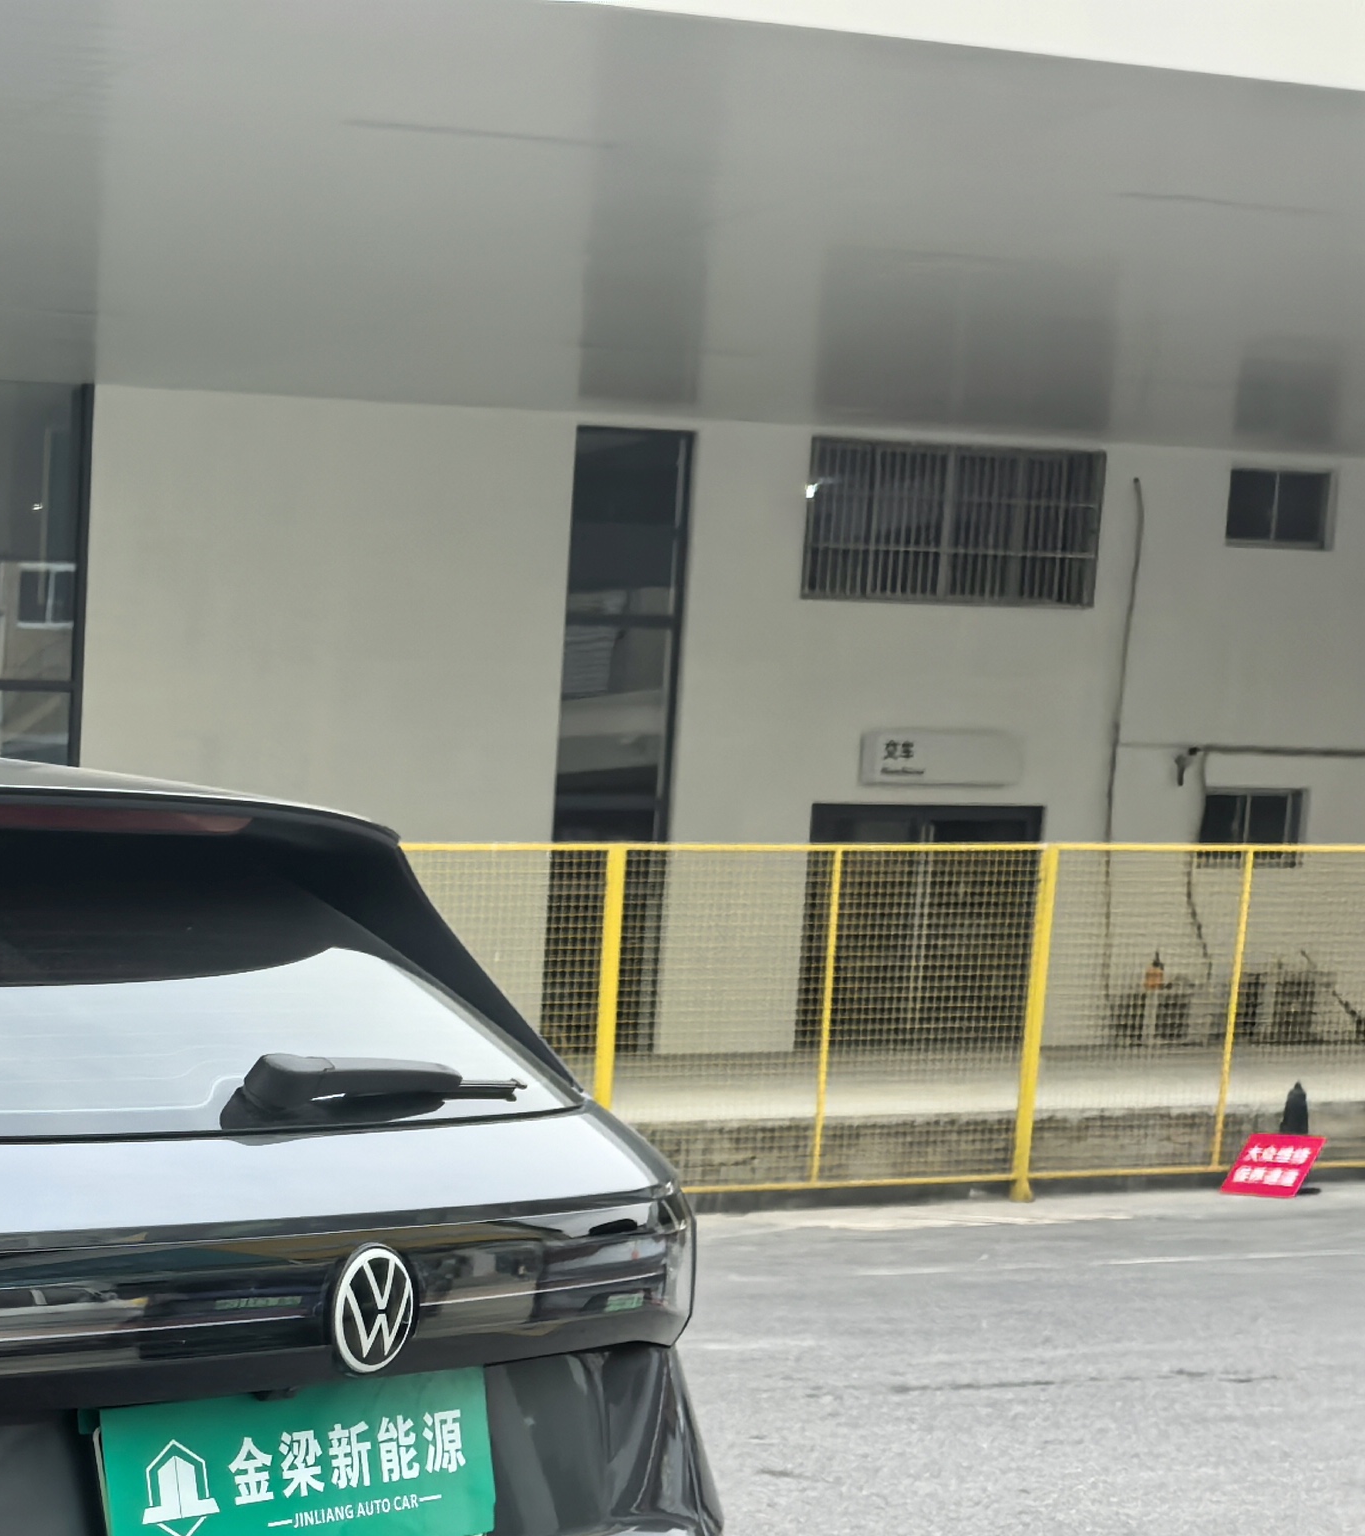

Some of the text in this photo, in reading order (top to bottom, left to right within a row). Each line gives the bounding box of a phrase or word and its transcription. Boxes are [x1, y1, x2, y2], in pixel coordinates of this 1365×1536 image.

[227, 1408, 467, 1507] 金梁新能源
[292, 1493, 419, 1529] JINLIANG AUTO CAR
